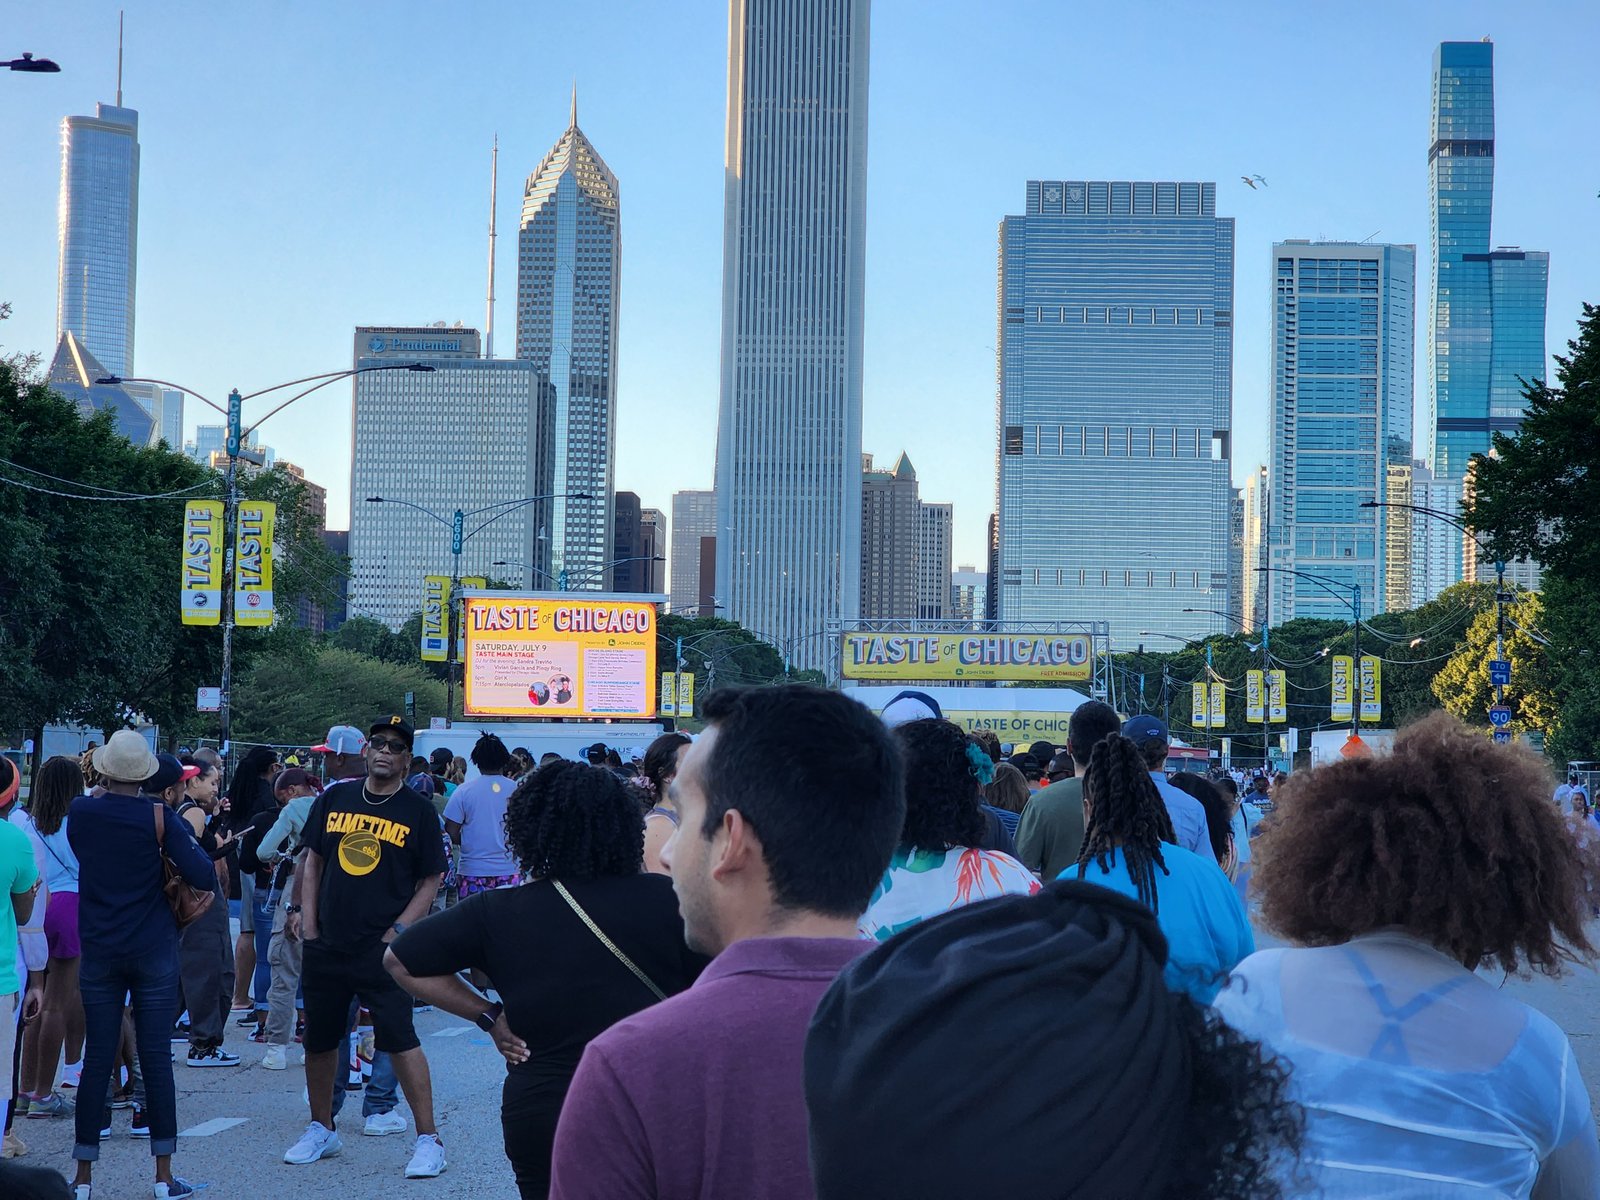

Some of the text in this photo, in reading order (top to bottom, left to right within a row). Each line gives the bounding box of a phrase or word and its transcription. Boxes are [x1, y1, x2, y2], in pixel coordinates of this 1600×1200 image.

[392, 338, 460, 351] Prudential
[228, 400, 240, 449] C610
[185, 508, 212, 590] TASTE
[238, 509, 262, 590] TASTE
[454, 516, 462, 550] C600
[426, 581, 442, 636] TASTE
[471, 606, 649, 633] TASTE OF CHICAGO
[848, 636, 1087, 665] TASTE OF CHICAGO
[681, 676, 689, 704] TASTE
[1248, 673, 1259, 707] TASTE
[1272, 673, 1280, 708] TASTE
[1334, 660, 1346, 702] TASTE
[1362, 660, 1375, 702] TASTE
[1194, 686, 1202, 714] TASTE
[1212, 686, 1220, 714] TASTE
[1492, 712, 1508, 722] 90
[390, 716, 401, 725] P
[967, 719, 1068, 732] TASTE OF CHIC
[326, 812, 410, 848] GAMETIME
